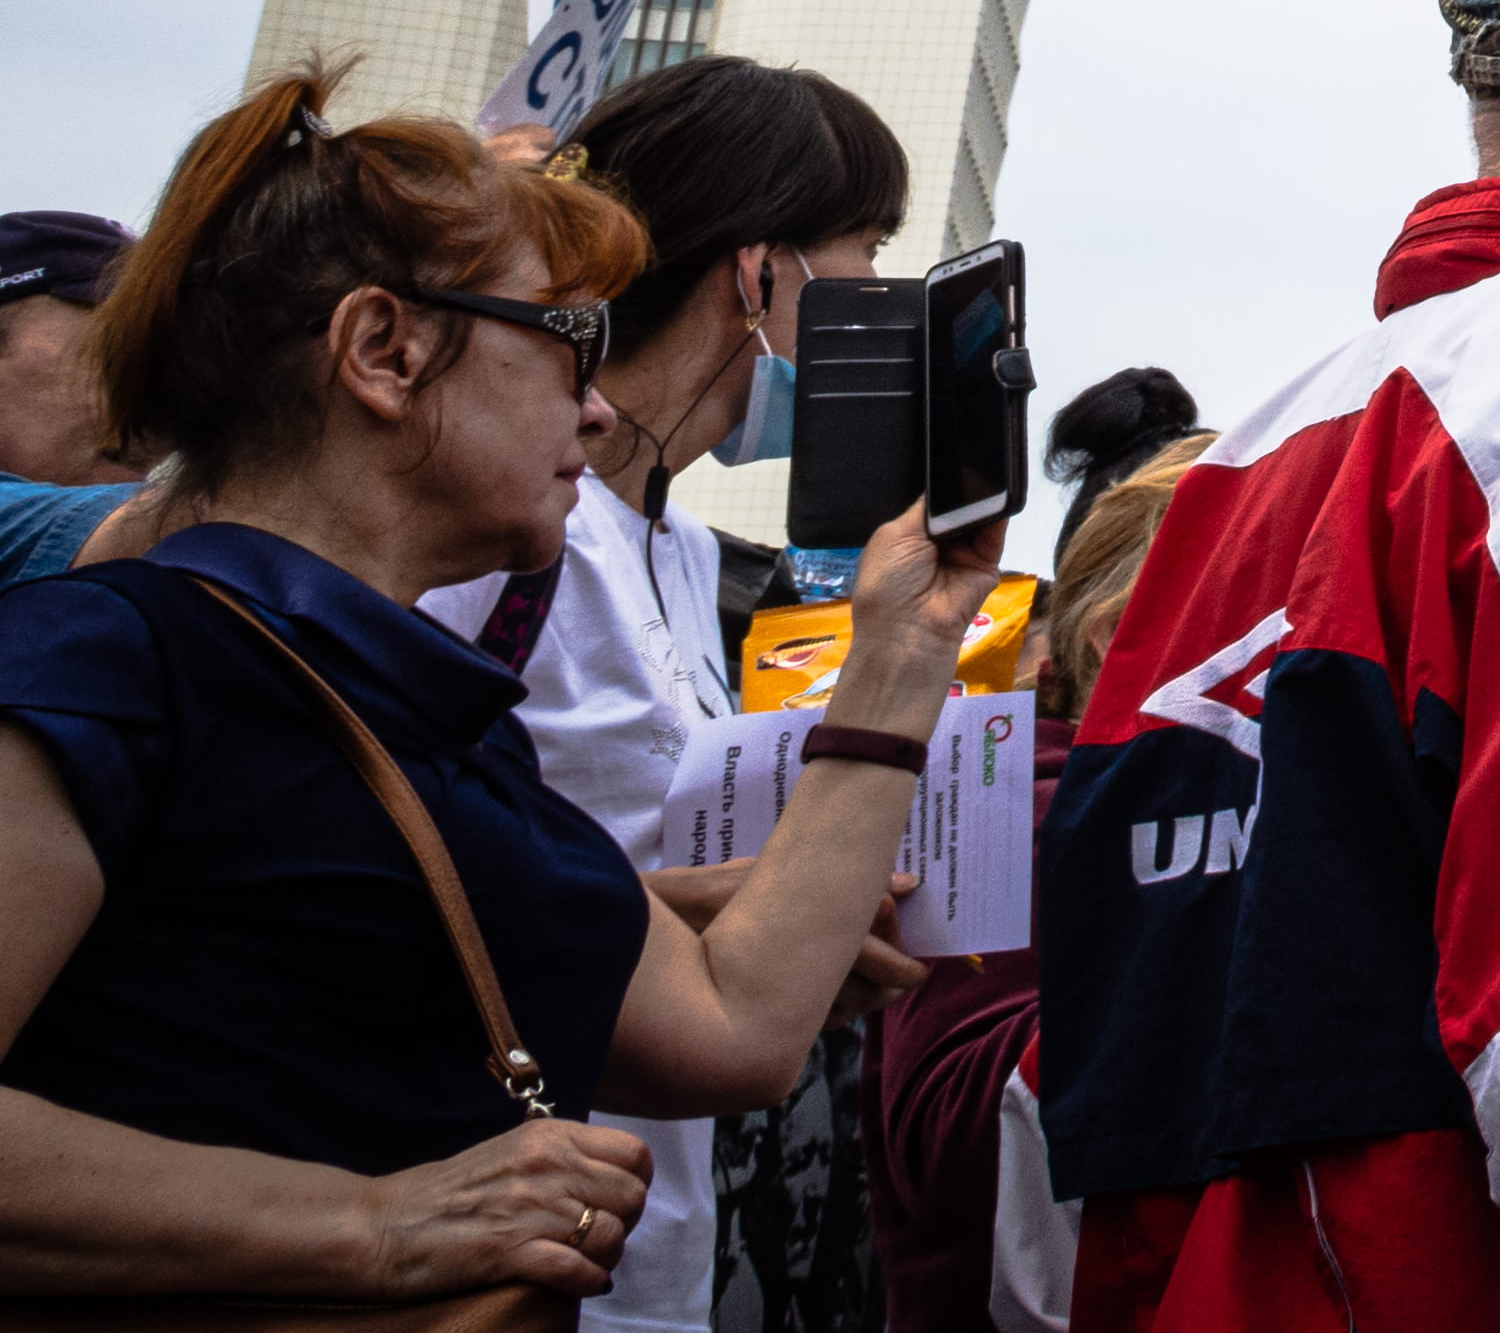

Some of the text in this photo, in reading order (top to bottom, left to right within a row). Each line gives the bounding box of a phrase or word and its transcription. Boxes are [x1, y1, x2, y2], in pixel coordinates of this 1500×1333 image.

[722, 745, 742, 813] Власть
[947, 734, 962, 922] Выбор граждан не должен быть
